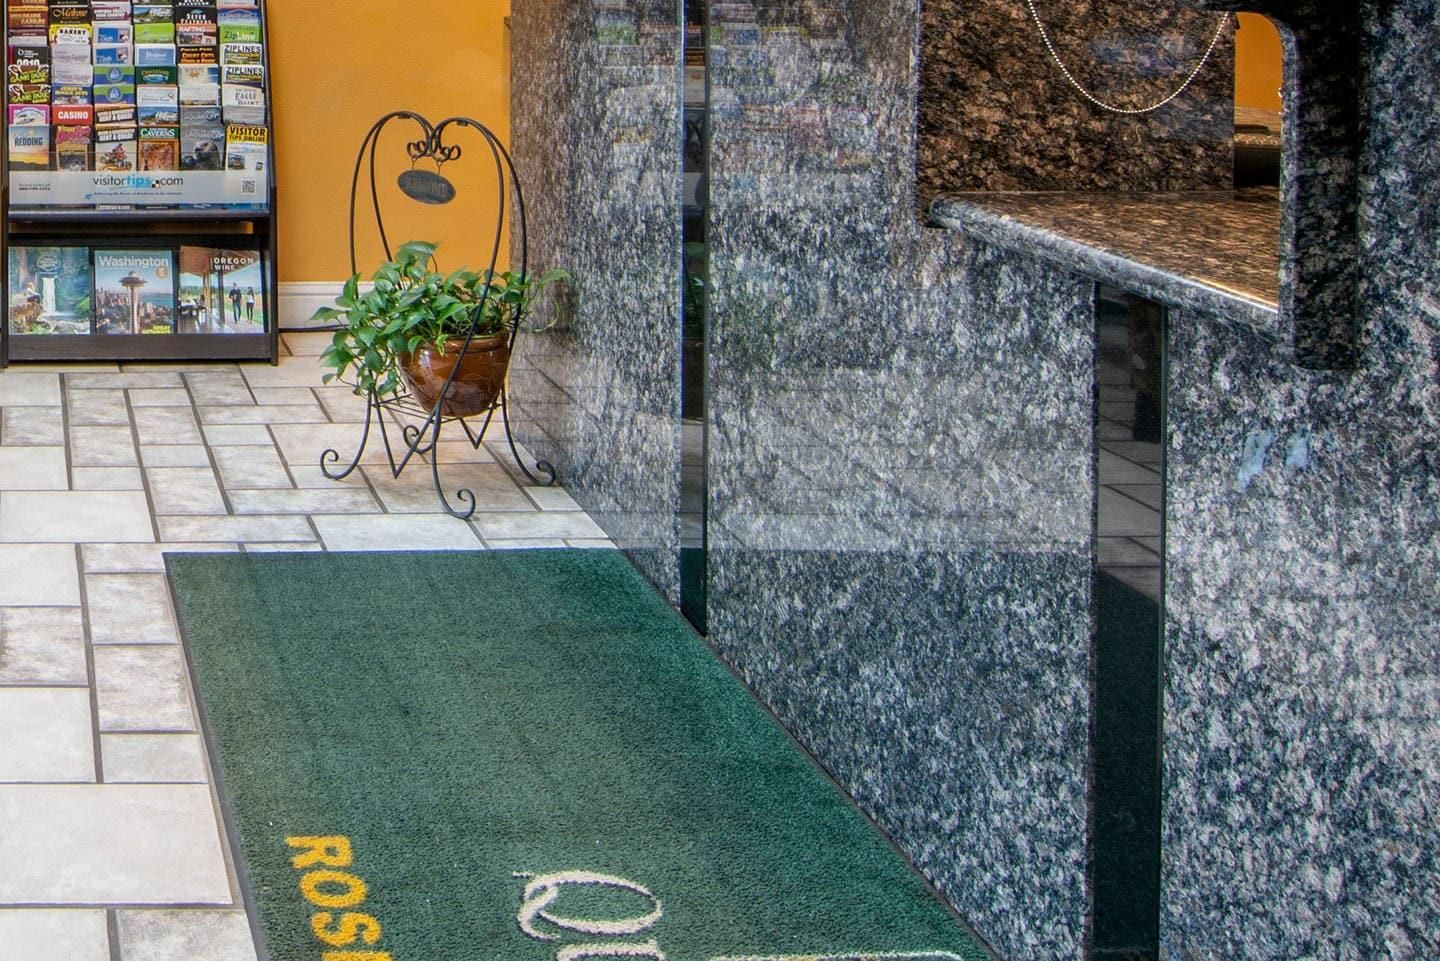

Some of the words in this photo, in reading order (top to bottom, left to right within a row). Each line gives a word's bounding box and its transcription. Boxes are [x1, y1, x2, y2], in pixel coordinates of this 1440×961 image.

[59, 28, 86, 36] BAKERY
[225, 44, 261, 53] ZIPLINES
[226, 66, 263, 76] ZIPLINES
[58, 111, 89, 120] CASINO
[230, 126, 266, 137] VISITOR
[14, 137, 43, 147] REDDING
[98, 256, 169, 269] Washington
[213, 257, 254, 265] OREGON
[284, 834, 394, 961] ROS
